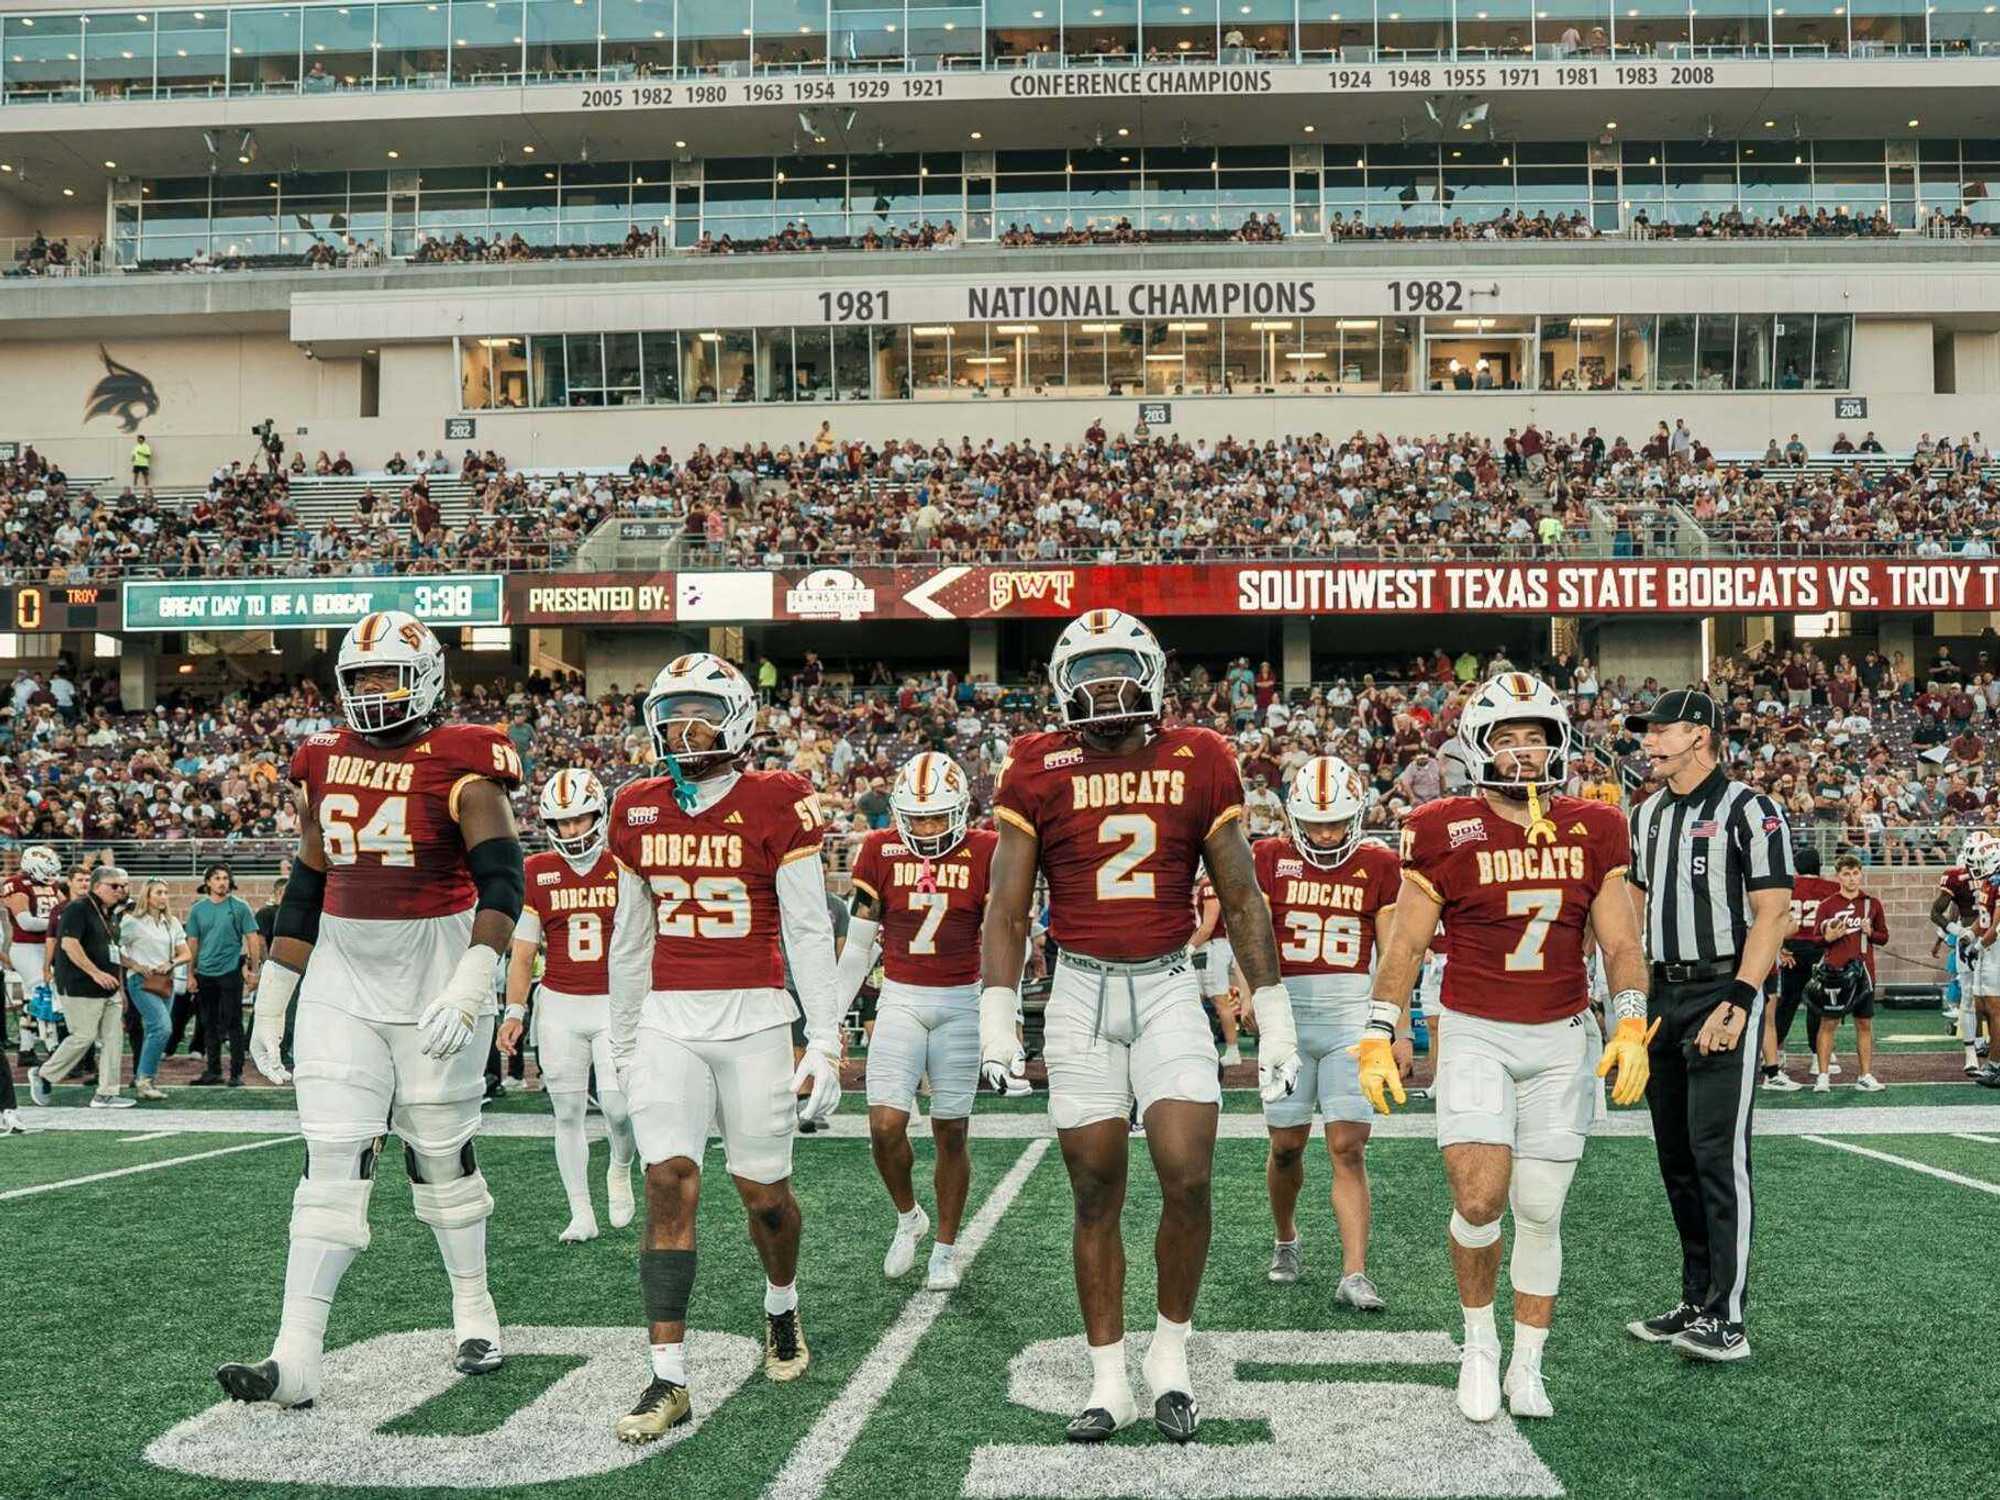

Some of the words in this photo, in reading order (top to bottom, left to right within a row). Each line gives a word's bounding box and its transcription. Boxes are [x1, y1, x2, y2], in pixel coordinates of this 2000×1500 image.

[582, 90, 623, 107] 2005
[632, 88, 673, 105] 1982
[686, 86, 727, 104] 1980
[743, 84, 784, 101] 1963
[794, 82, 835, 100] 1954
[848, 81, 889, 98] 1929
[903, 79, 943, 97] 1921
[1010, 74, 1141, 96] CONFERENCE
[1146, 71, 1271, 94] CHAMPIONS
[1328, 71, 1371, 88] 1924
[1388, 70, 1431, 87] 1948
[1443, 69, 1486, 87] 1955
[1499, 69, 1539, 86] 1971
[1556, 68, 1598, 85] 1981
[1616, 67, 1657, 84] 1983
[1671, 67, 1714, 84] 2008
[818, 290, 889, 321] 1981
[968, 285, 1120, 318] NATIONAL
[1128, 282, 1315, 316] CHAMPIONS
[1387, 281, 1463, 312] 1982
[1144, 410, 1166, 422] 203
[1840, 404, 1862, 417] 204
[449, 425, 471, 437] 202
[66, 589, 98, 604] TROY
[414, 585, 472, 617] 3:38
[529, 587, 634, 613] PRESENTED
[638, 586, 670, 611] BY:
[1238, 569, 1436, 610] SOUTHWEST
[1445, 568, 1548, 608] TEXAS
[1558, 568, 1657, 608] STATE
[1667, 567, 1818, 606] BOBCATS
[1827, 566, 1879, 606] VS.
[1886, 566, 1971, 606] TROY
[18, 589, 41, 629] 0
[211, 596, 242, 616] DAY
[245, 595, 266, 616] TO
[271, 594, 292, 615] BE
[294, 595, 308, 615] A
[312, 593, 373, 615] BOBCAT
[326, 754, 415, 792] BOBCATS
[1071, 770, 1185, 810] BOBCATS
[319, 794, 416, 867] 64
[1649, 825, 1659, 839] S
[640, 834, 744, 868] BOBCATS
[1096, 813, 1157, 900] 2
[1476, 846, 1585, 885] BOBCATS
[1693, 856, 1706, 875] S
[550, 887, 616, 910] BOBCATS
[649, 875, 752, 939] 29
[1285, 880, 1364, 912] BOBCATS
[567, 913, 604, 962] 8
[908, 892, 949, 955] 7
[1281, 910, 1361, 968] 36
[1505, 888, 1563, 971] 7
